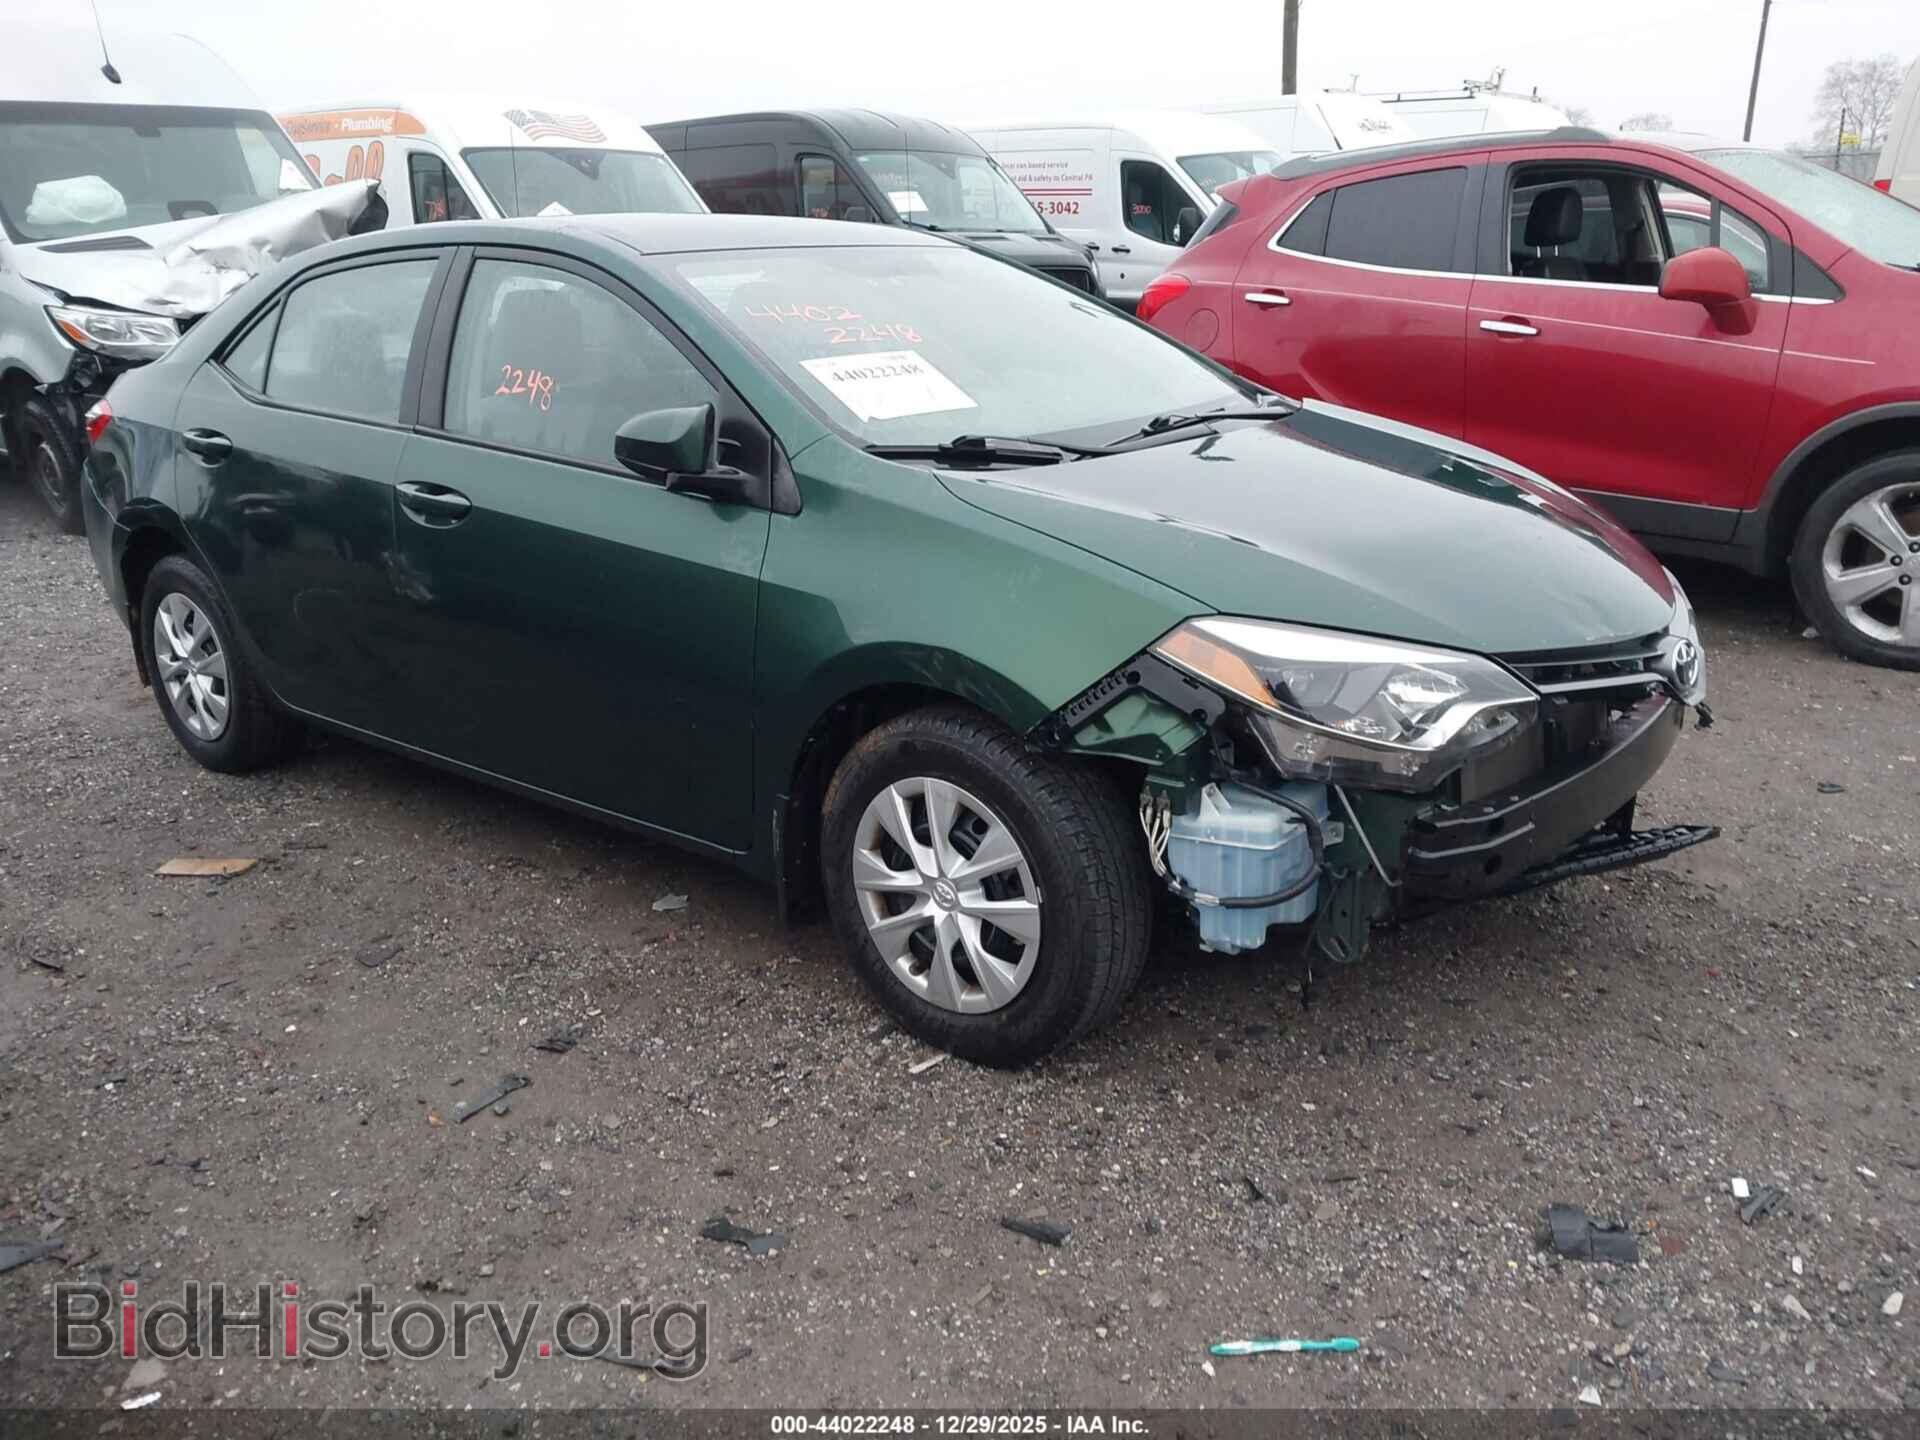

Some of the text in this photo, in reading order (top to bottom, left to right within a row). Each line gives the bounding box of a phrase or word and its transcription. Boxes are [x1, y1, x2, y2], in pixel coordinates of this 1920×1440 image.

[341, 115, 393, 134] Plumbing
[1031, 201, 1080, 215] 5-3042
[745, 303, 863, 324] 4402
[823, 322, 923, 344] 2248
[496, 363, 553, 411] 2248
